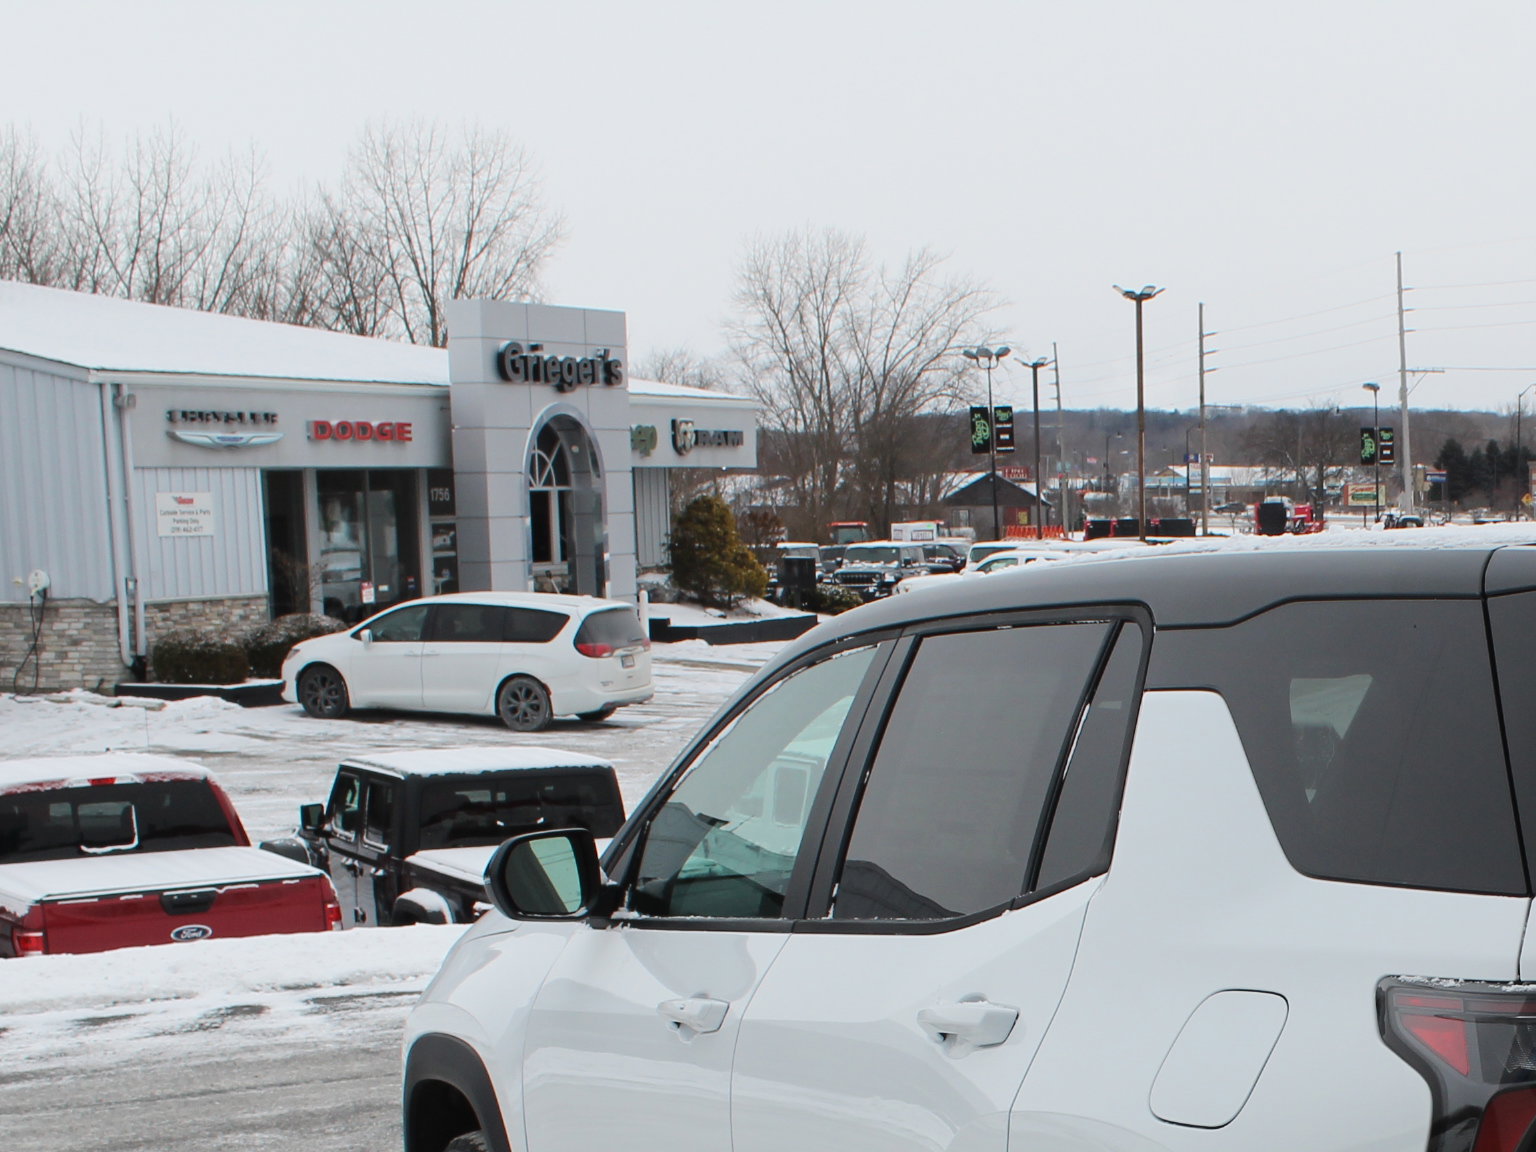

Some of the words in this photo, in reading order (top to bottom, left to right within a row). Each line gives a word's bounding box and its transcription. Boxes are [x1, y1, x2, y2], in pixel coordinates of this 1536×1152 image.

[497, 340, 624, 393] Grieger's
[309, 420, 413, 442] DODGE
[430, 487, 451, 502] 1756
